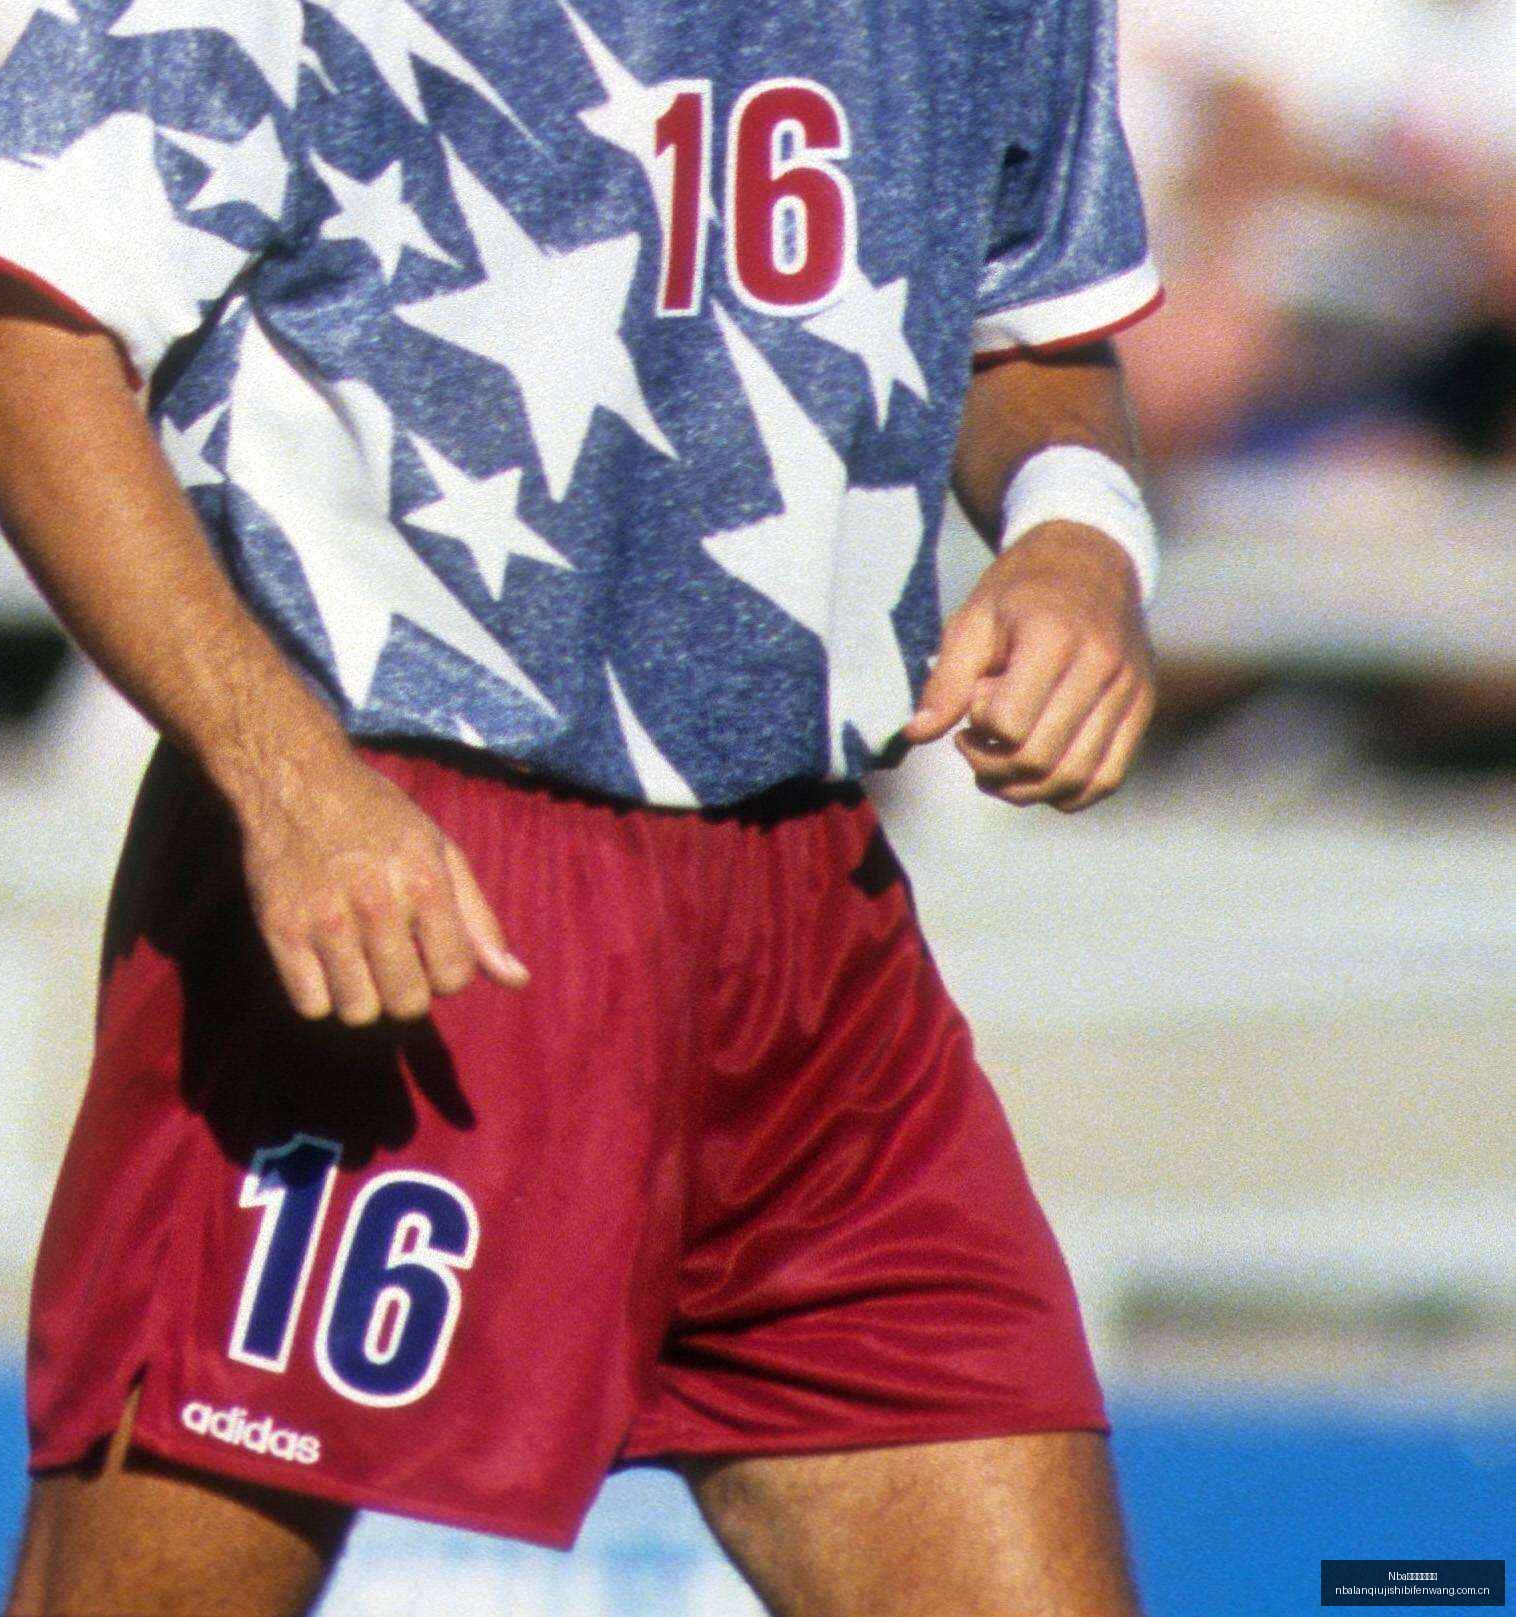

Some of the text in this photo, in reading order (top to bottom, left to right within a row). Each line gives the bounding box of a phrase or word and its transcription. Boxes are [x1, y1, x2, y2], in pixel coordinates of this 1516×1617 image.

[652, 76, 858, 318] 16
[227, 1132, 481, 1409] 16
[180, 1399, 321, 1465] adidas
